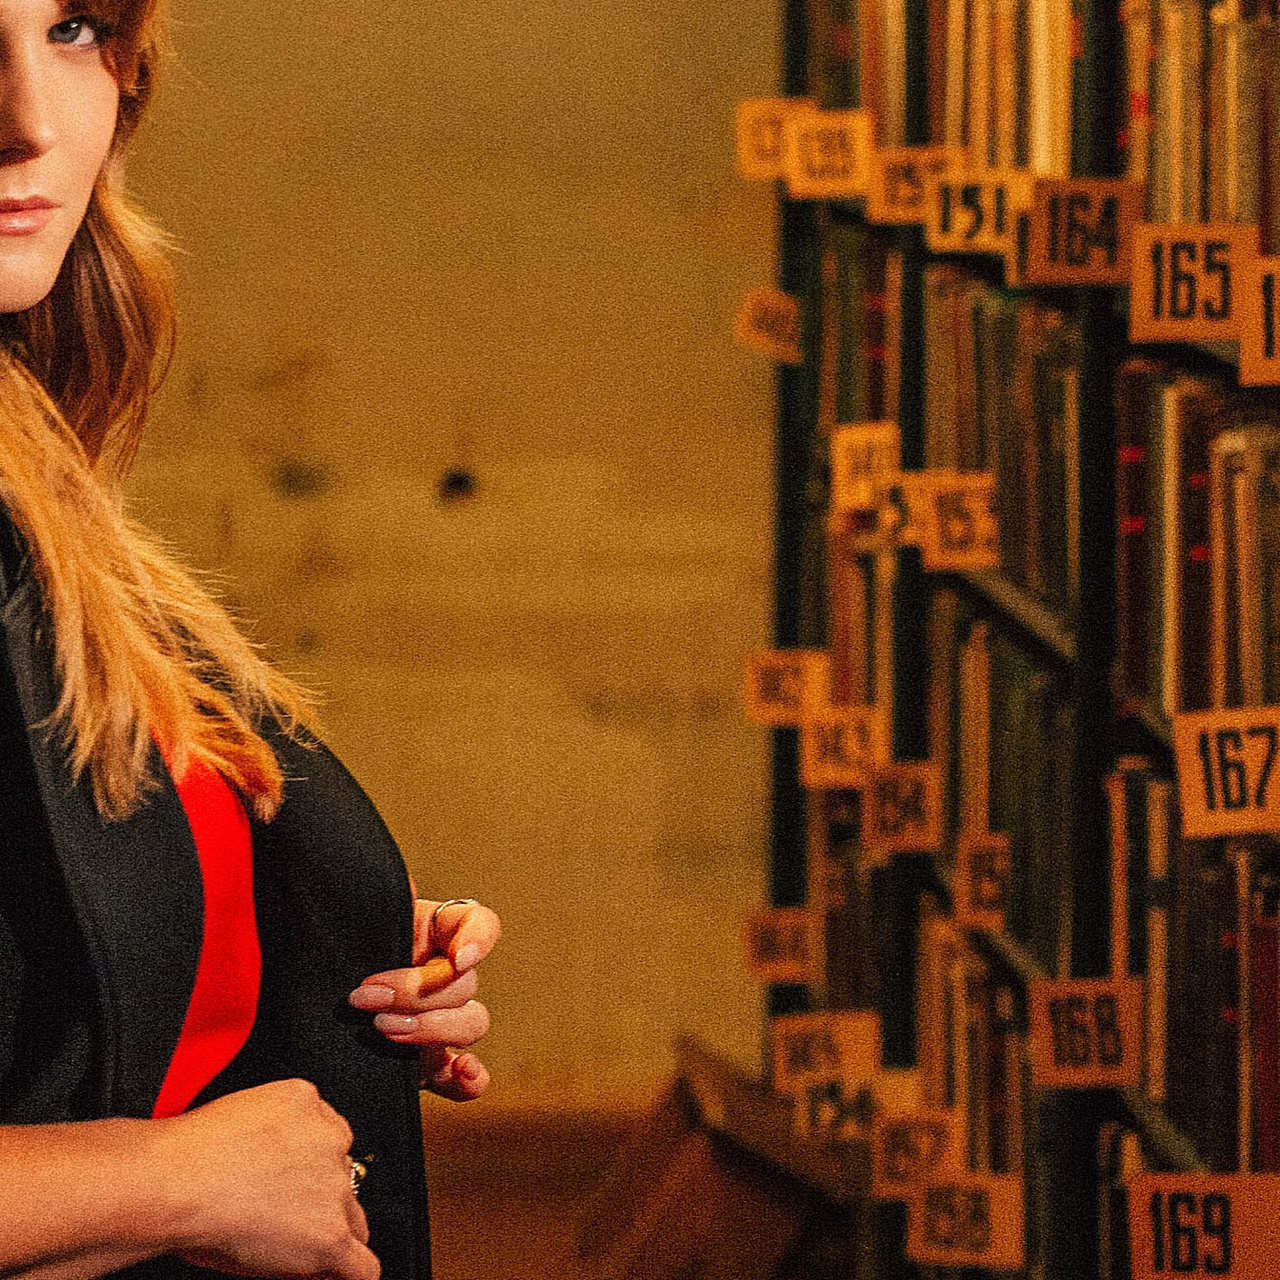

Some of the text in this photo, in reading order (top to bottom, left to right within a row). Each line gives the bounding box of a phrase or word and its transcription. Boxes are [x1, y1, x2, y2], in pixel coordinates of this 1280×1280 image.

[939, 182, 1005, 238] 151
[1048, 194, 1119, 266] 164
[1153, 240, 1232, 320] 165
[1197, 725, 1279, 811] 167
[1049, 994, 1122, 1068] 168
[1150, 1191, 1232, 1274] 169
